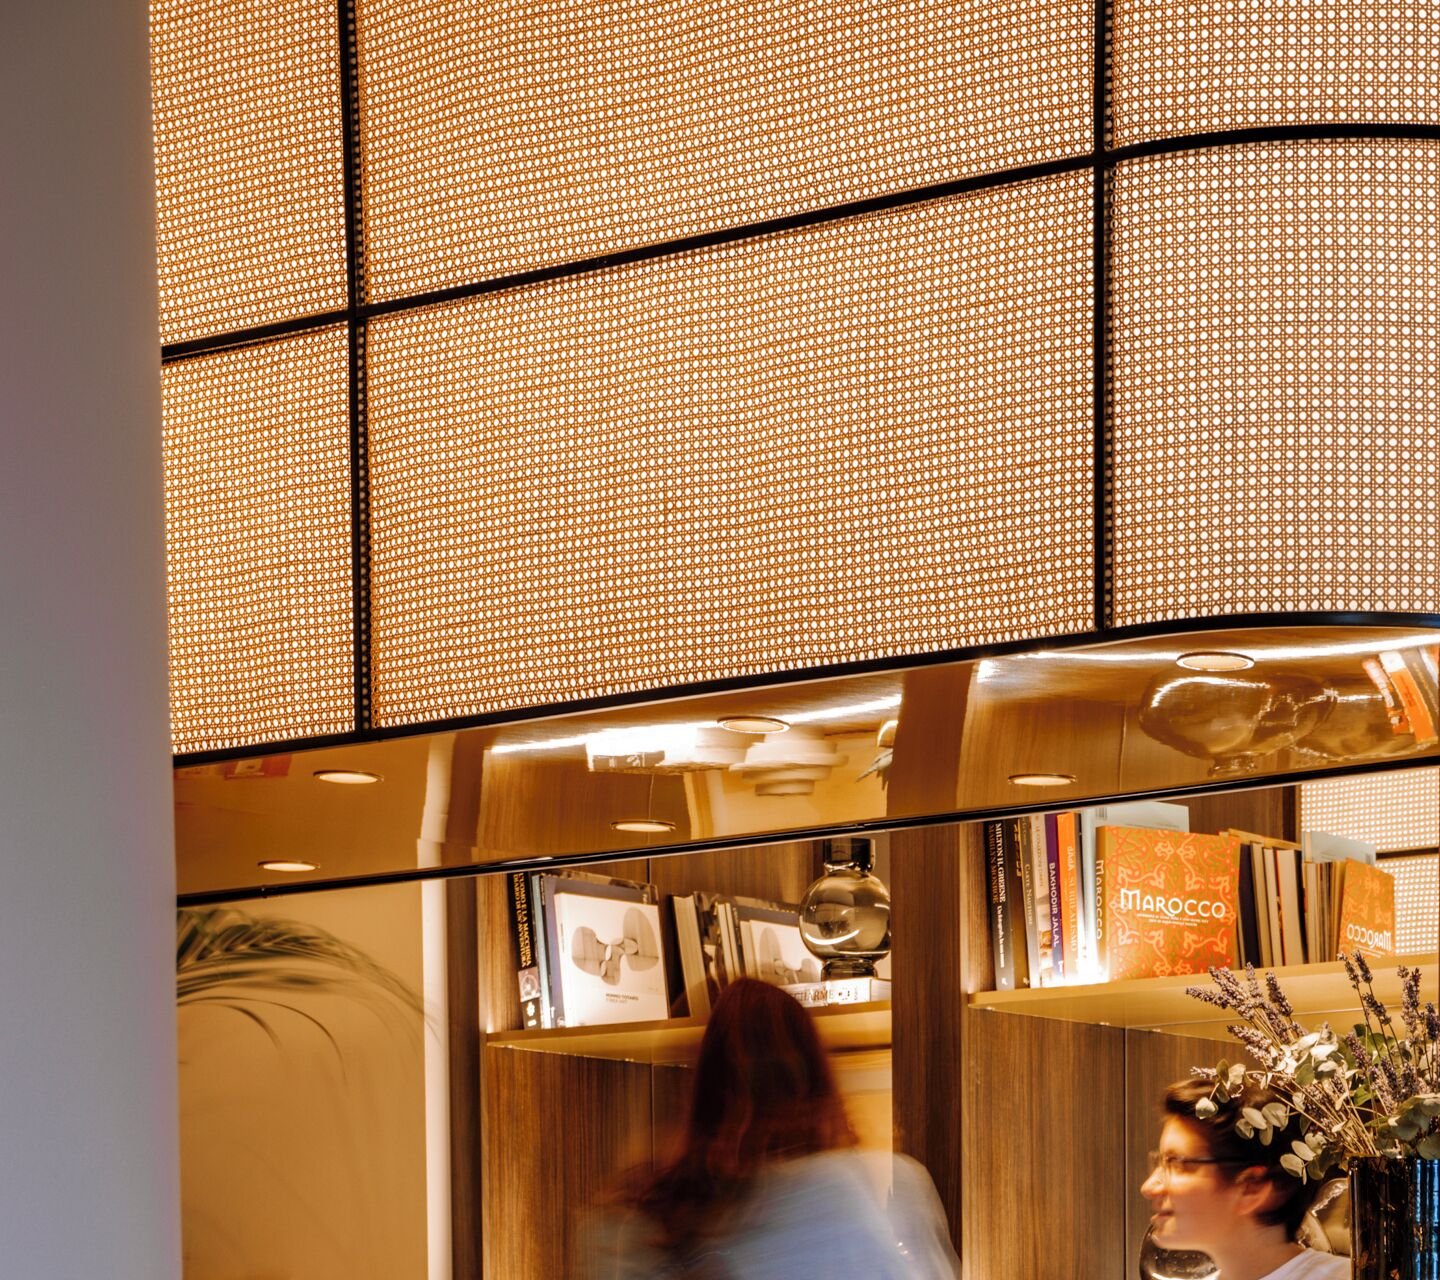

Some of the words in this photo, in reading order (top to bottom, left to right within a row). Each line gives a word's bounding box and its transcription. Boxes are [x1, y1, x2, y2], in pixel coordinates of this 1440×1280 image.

[995, 823, 1003, 857] MILTON
[991, 865, 999, 904] MONROE
[998, 867, 1006, 903] GREENE
[1049, 863, 1058, 914] BAKHODIR
[1120, 888, 1226, 918] MAROCCO
[523, 923, 532, 966] MACCHINA
[1052, 917, 1060, 947] JALAL
